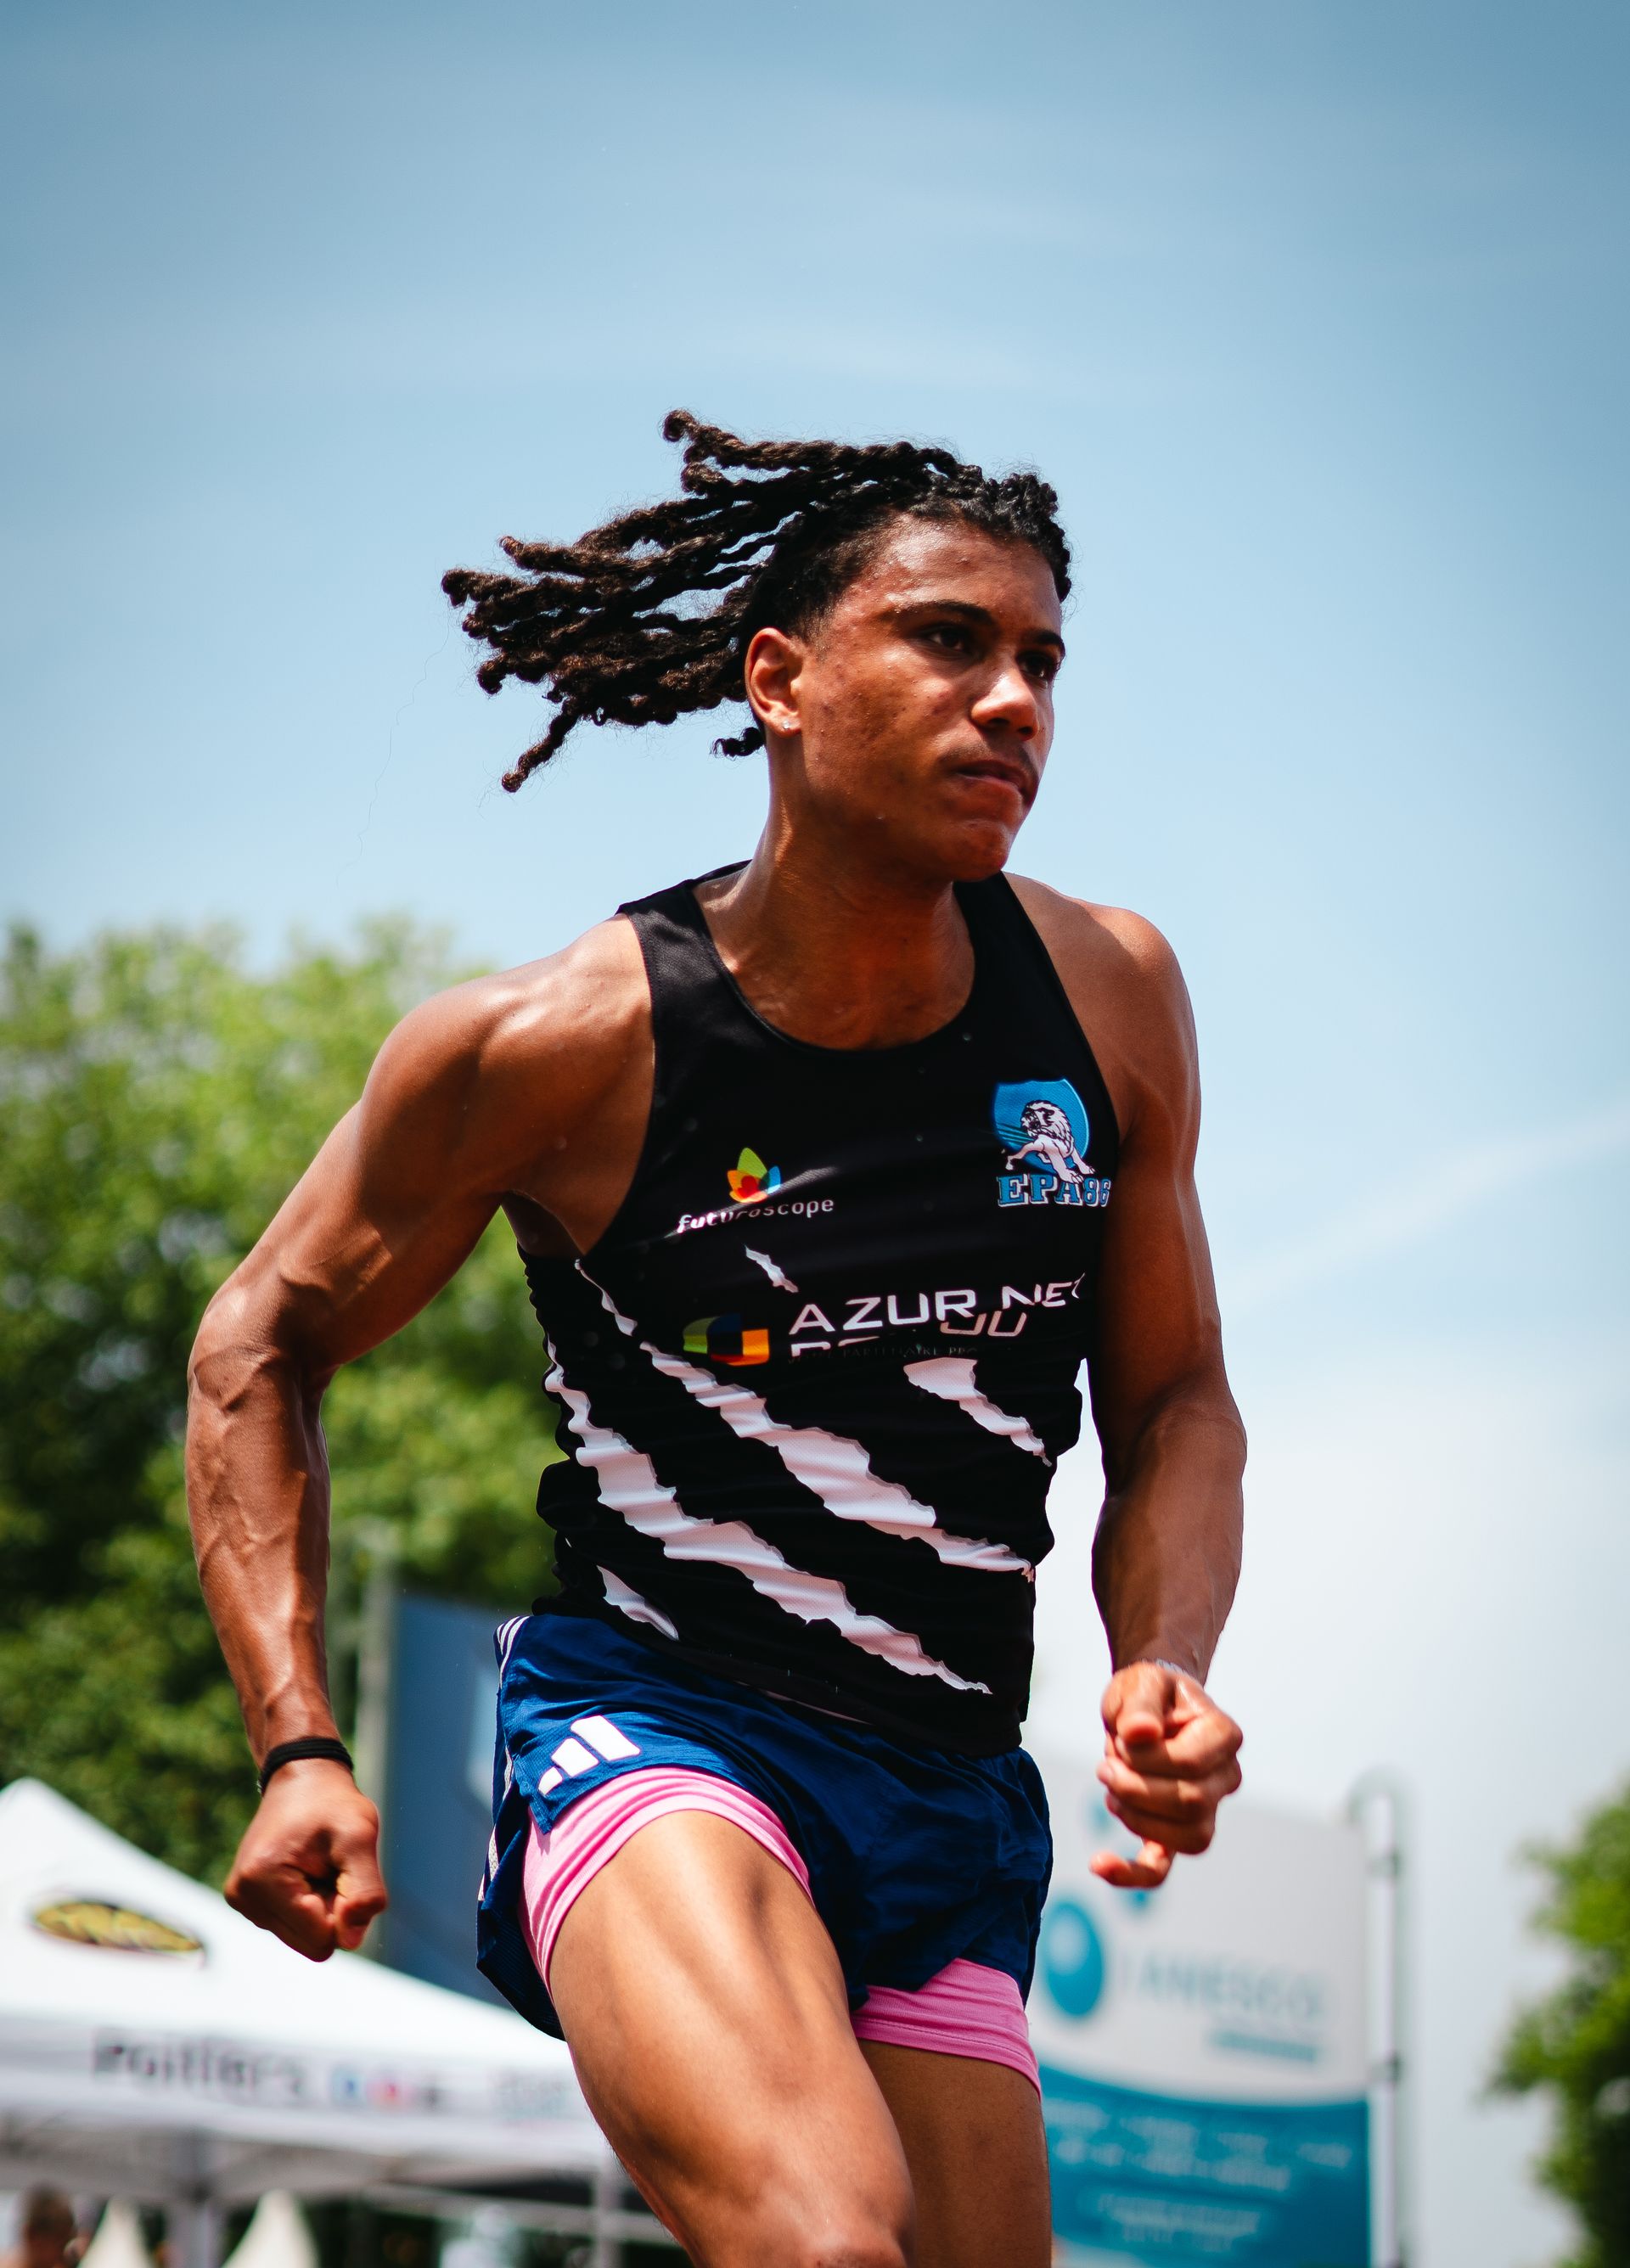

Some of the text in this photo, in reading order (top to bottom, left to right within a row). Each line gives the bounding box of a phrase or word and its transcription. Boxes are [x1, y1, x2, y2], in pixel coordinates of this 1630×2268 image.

[997, 1173, 1111, 1207] EPA86
[677, 1199, 835, 1233] futuroscope
[788, 1289, 976, 1335] AZUR
